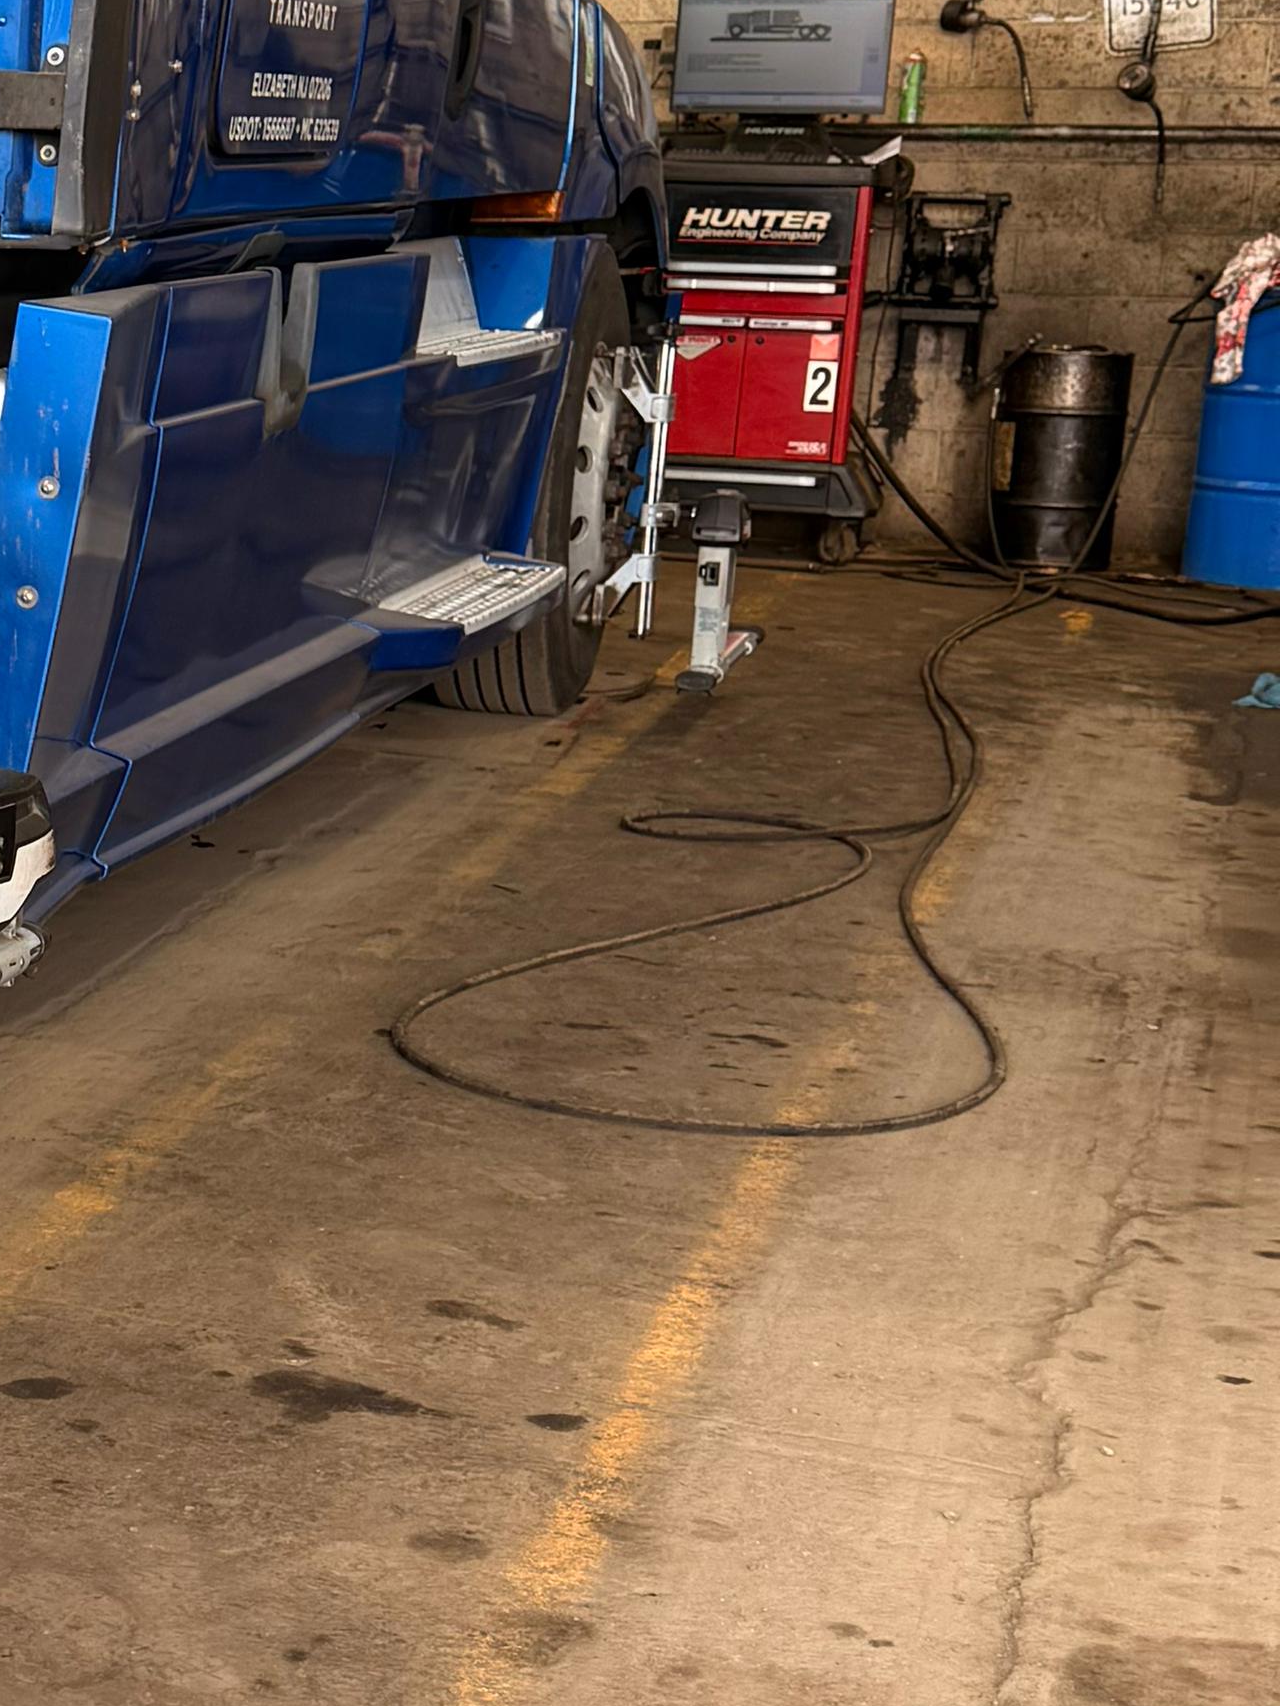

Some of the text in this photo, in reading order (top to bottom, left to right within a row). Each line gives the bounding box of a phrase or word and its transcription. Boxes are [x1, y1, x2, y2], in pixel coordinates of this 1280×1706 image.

[251, 72, 297, 99] ELIZABETH
[296, 76, 308, 99] NJ
[228, 116, 262, 141] USDOT:
[300, 117, 315, 141] MC
[683, 206, 832, 230] HUNTER
[678, 225, 826, 243] Engineering Company
[808, 366, 833, 406] 2
